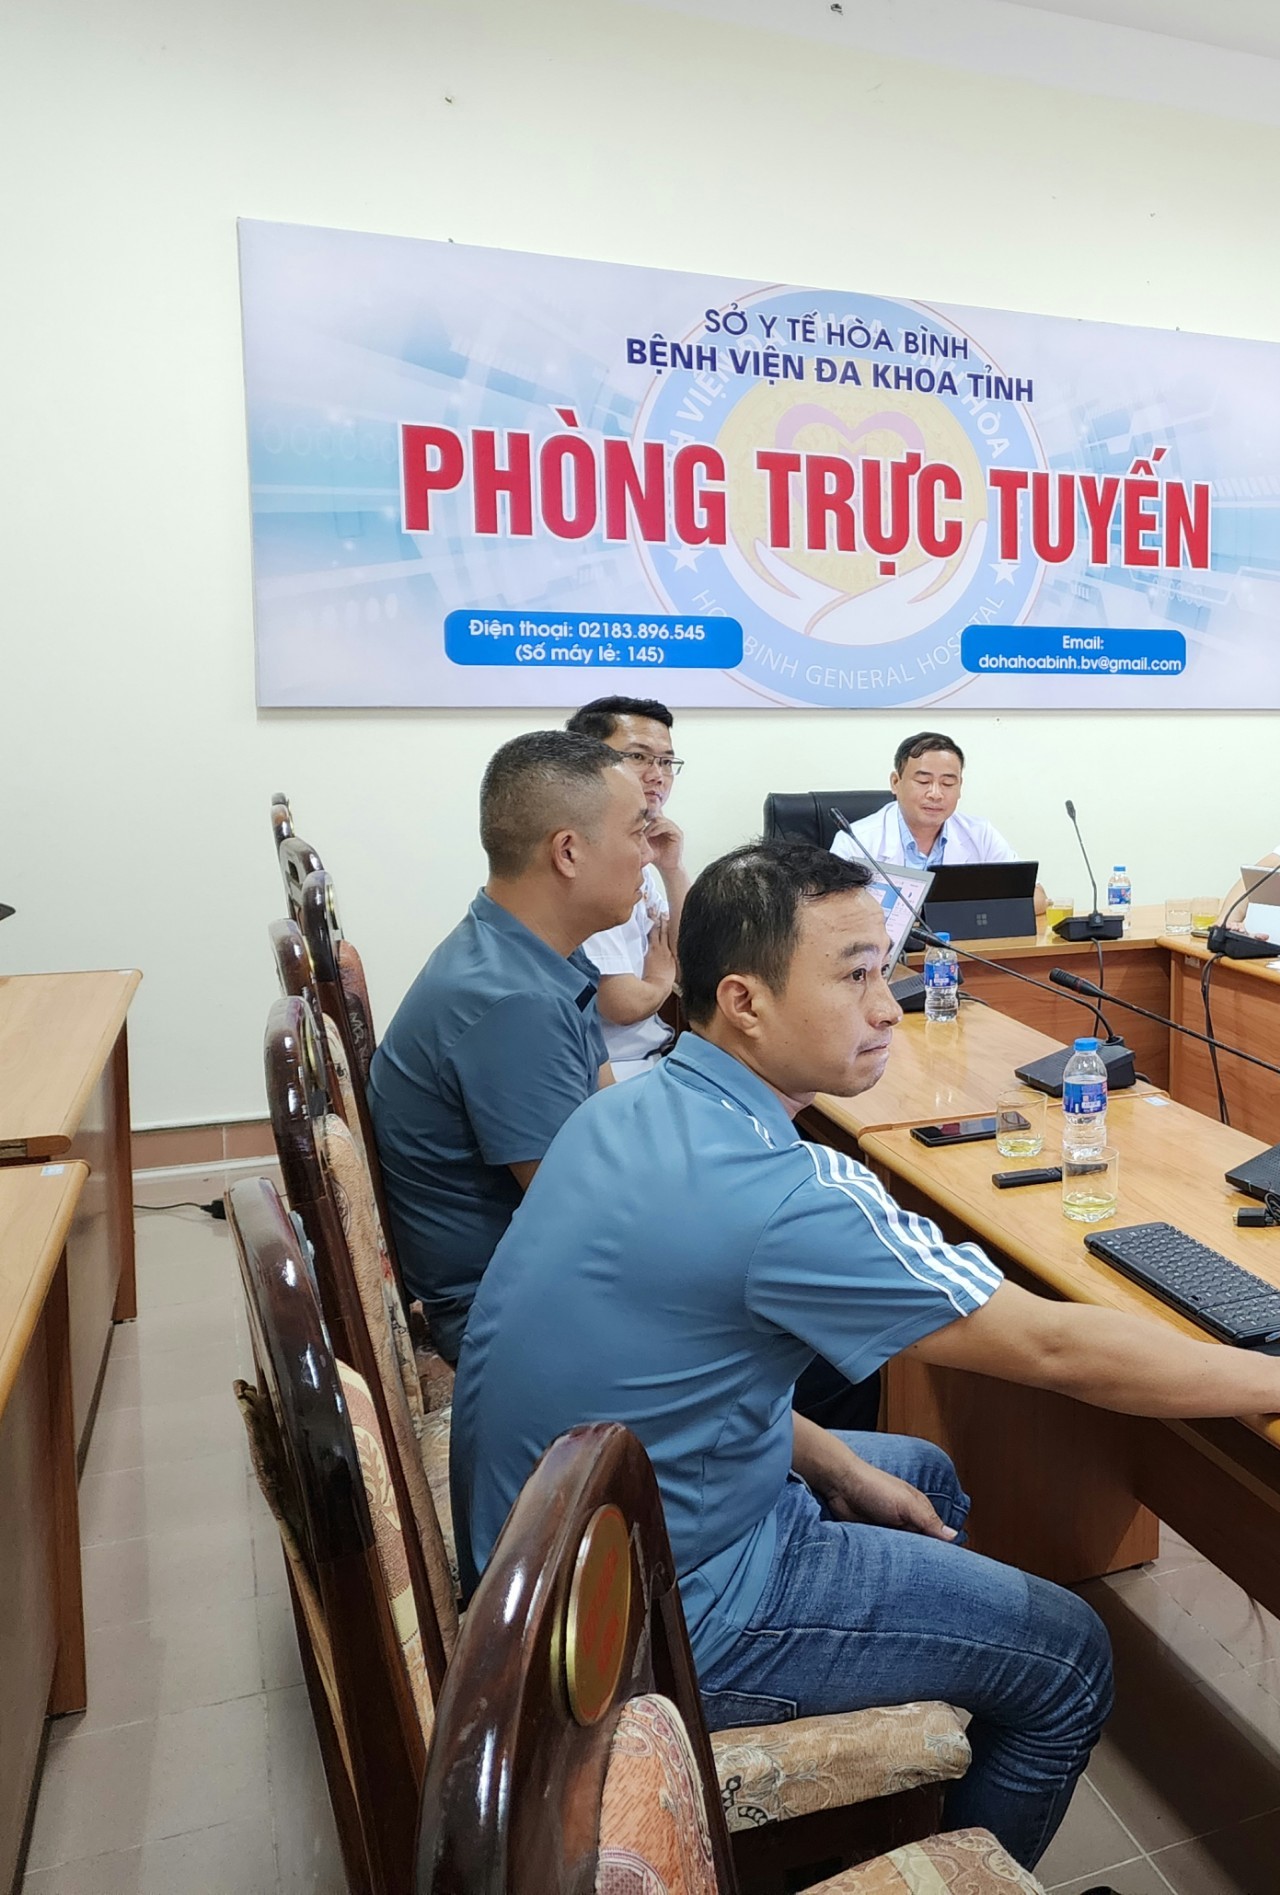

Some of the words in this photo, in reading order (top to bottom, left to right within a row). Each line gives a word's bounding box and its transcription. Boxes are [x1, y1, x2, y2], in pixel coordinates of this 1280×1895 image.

[705, 302, 748, 335] SỞ
[758, 315, 777, 338] Y
[786, 311, 818, 343] TẾ
[827, 318, 894, 351] HÒA
[904, 325, 968, 360] BÌNH
[627, 333, 717, 375] BỆNH
[729, 345, 804, 385] VIỆN
[813, 357, 862, 386] ĐA
[873, 363, 958, 396] KHOA
[967, 364, 1033, 403] TỈNH
[402, 408, 728, 546] PHÒNG
[756, 450, 963, 577] TRỰC
[989, 446, 1210, 570] TUYẾN
[468, 619, 514, 639] Điện
[519, 620, 573, 641] thoại:
[578, 621, 705, 641] 02183.896.545
[805, 664, 915, 690] GENERAL
[917, 597, 1004, 675] HOSTAL
[1062, 635, 1104, 650] Email:
[515, 642, 546, 662] (Số
[550, 644, 594, 665] máy
[598, 643, 620, 662] lẻ:
[628, 646, 665, 664] 145)
[978, 654, 1182, 674] dohahoabinh.bv@gmail.com
